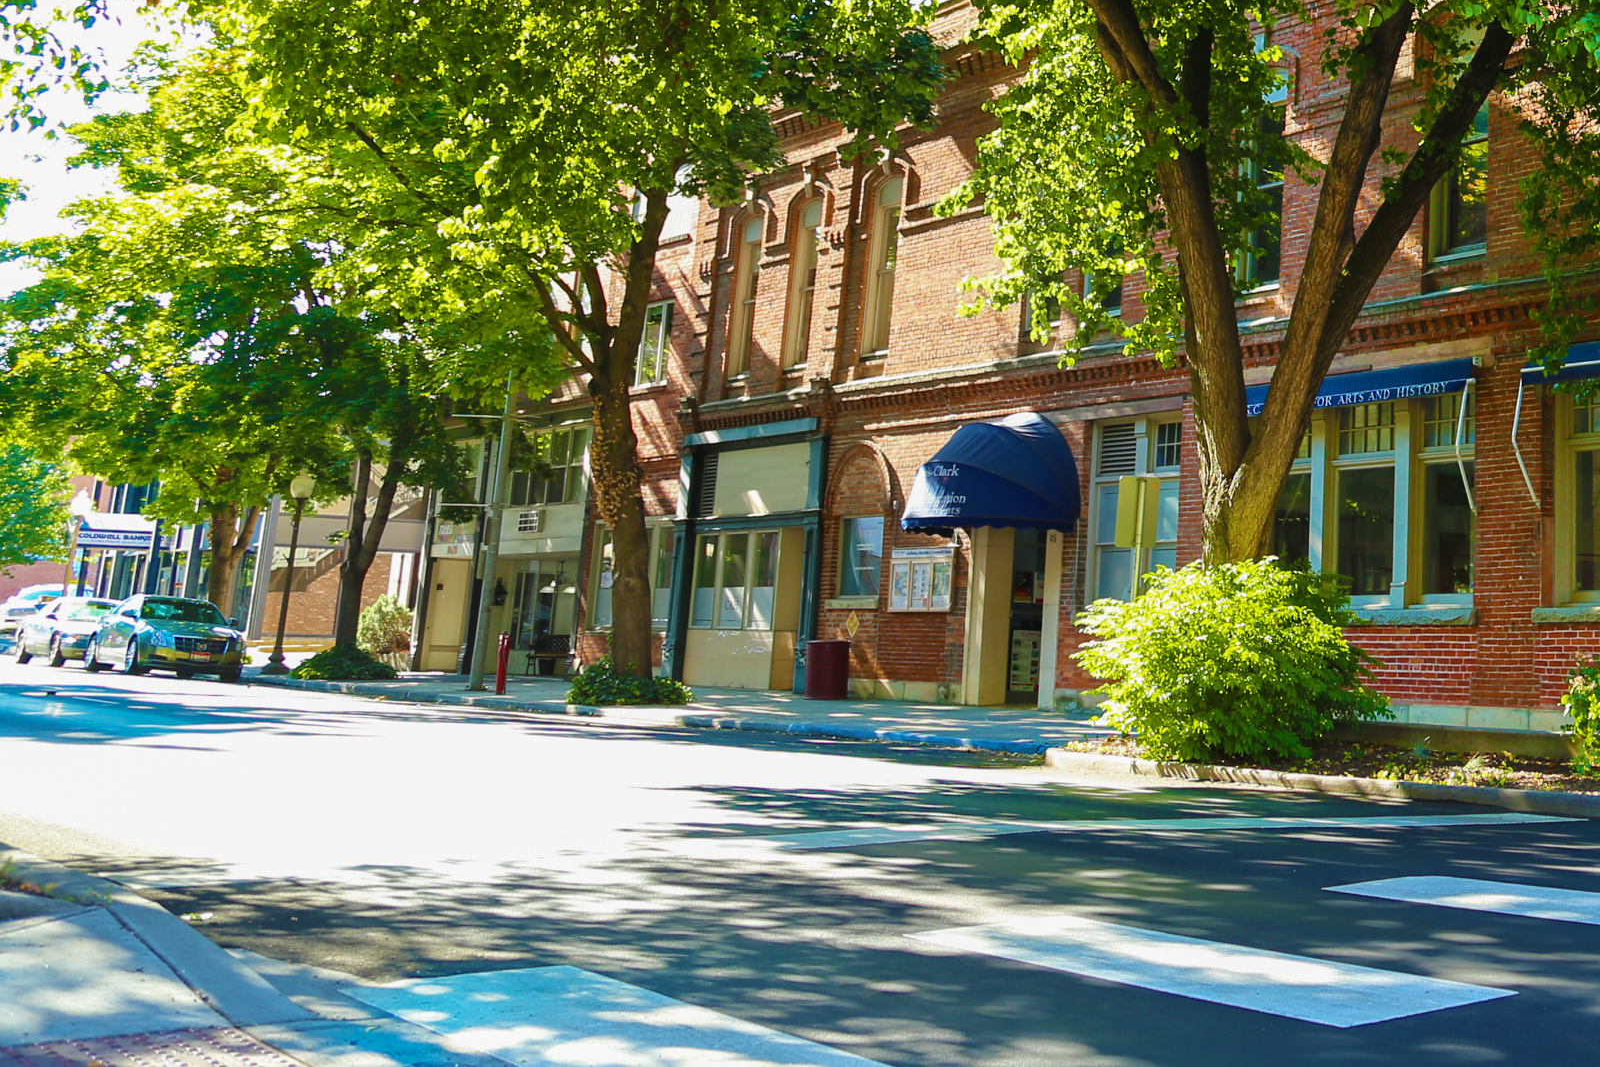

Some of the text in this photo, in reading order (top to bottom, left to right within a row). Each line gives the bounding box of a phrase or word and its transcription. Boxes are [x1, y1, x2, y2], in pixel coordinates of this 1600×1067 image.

[1337, 391, 1364, 405] ARTS
[1368, 388, 1390, 401] AND
[1396, 381, 1449, 398] HISTORY
[78, 532, 121, 540] COLDWELL
